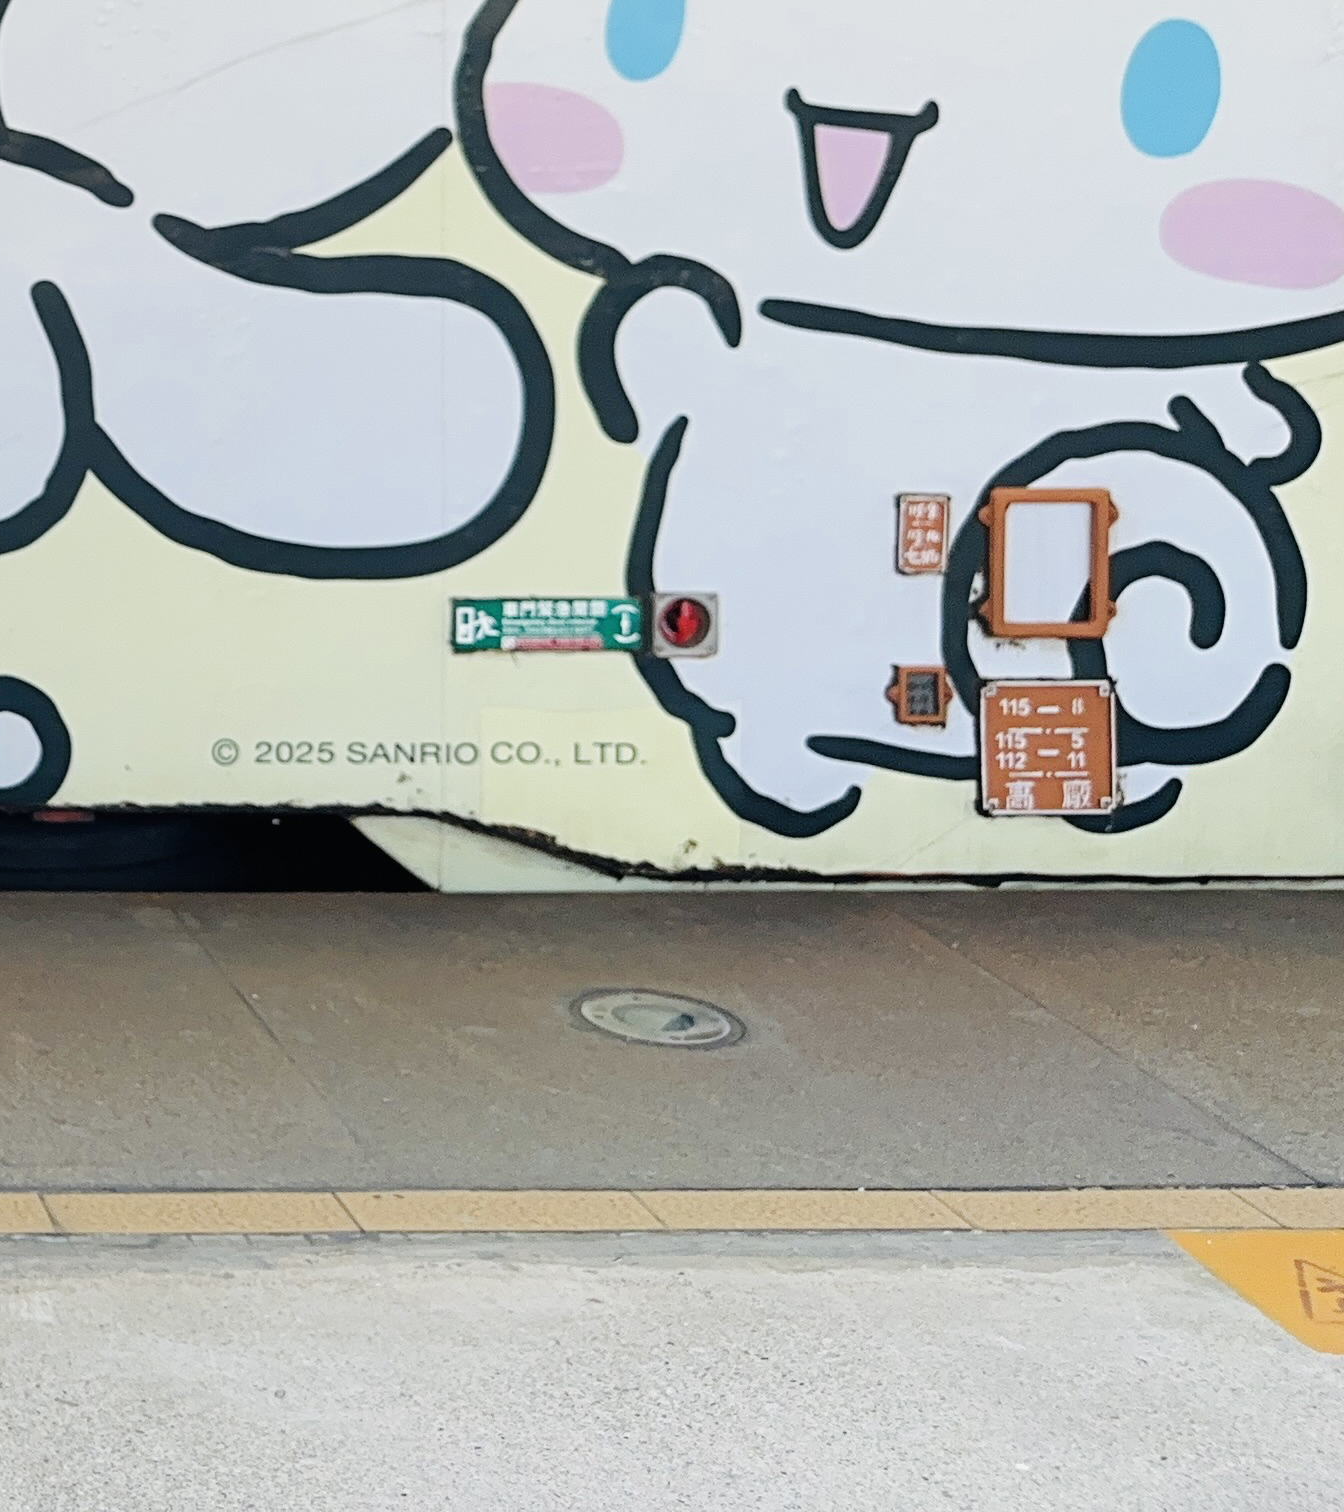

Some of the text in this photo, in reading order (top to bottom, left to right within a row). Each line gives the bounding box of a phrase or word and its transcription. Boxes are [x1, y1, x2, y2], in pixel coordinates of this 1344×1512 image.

[998, 697, 1032, 717] 115
[995, 730, 1028, 749] 115
[254, 740, 336, 765] 2025
[346, 741, 480, 766] SANRIO
[490, 741, 561, 768] CO.,
[573, 742, 648, 766] LTD.
[995, 750, 1087, 769] 112 11
